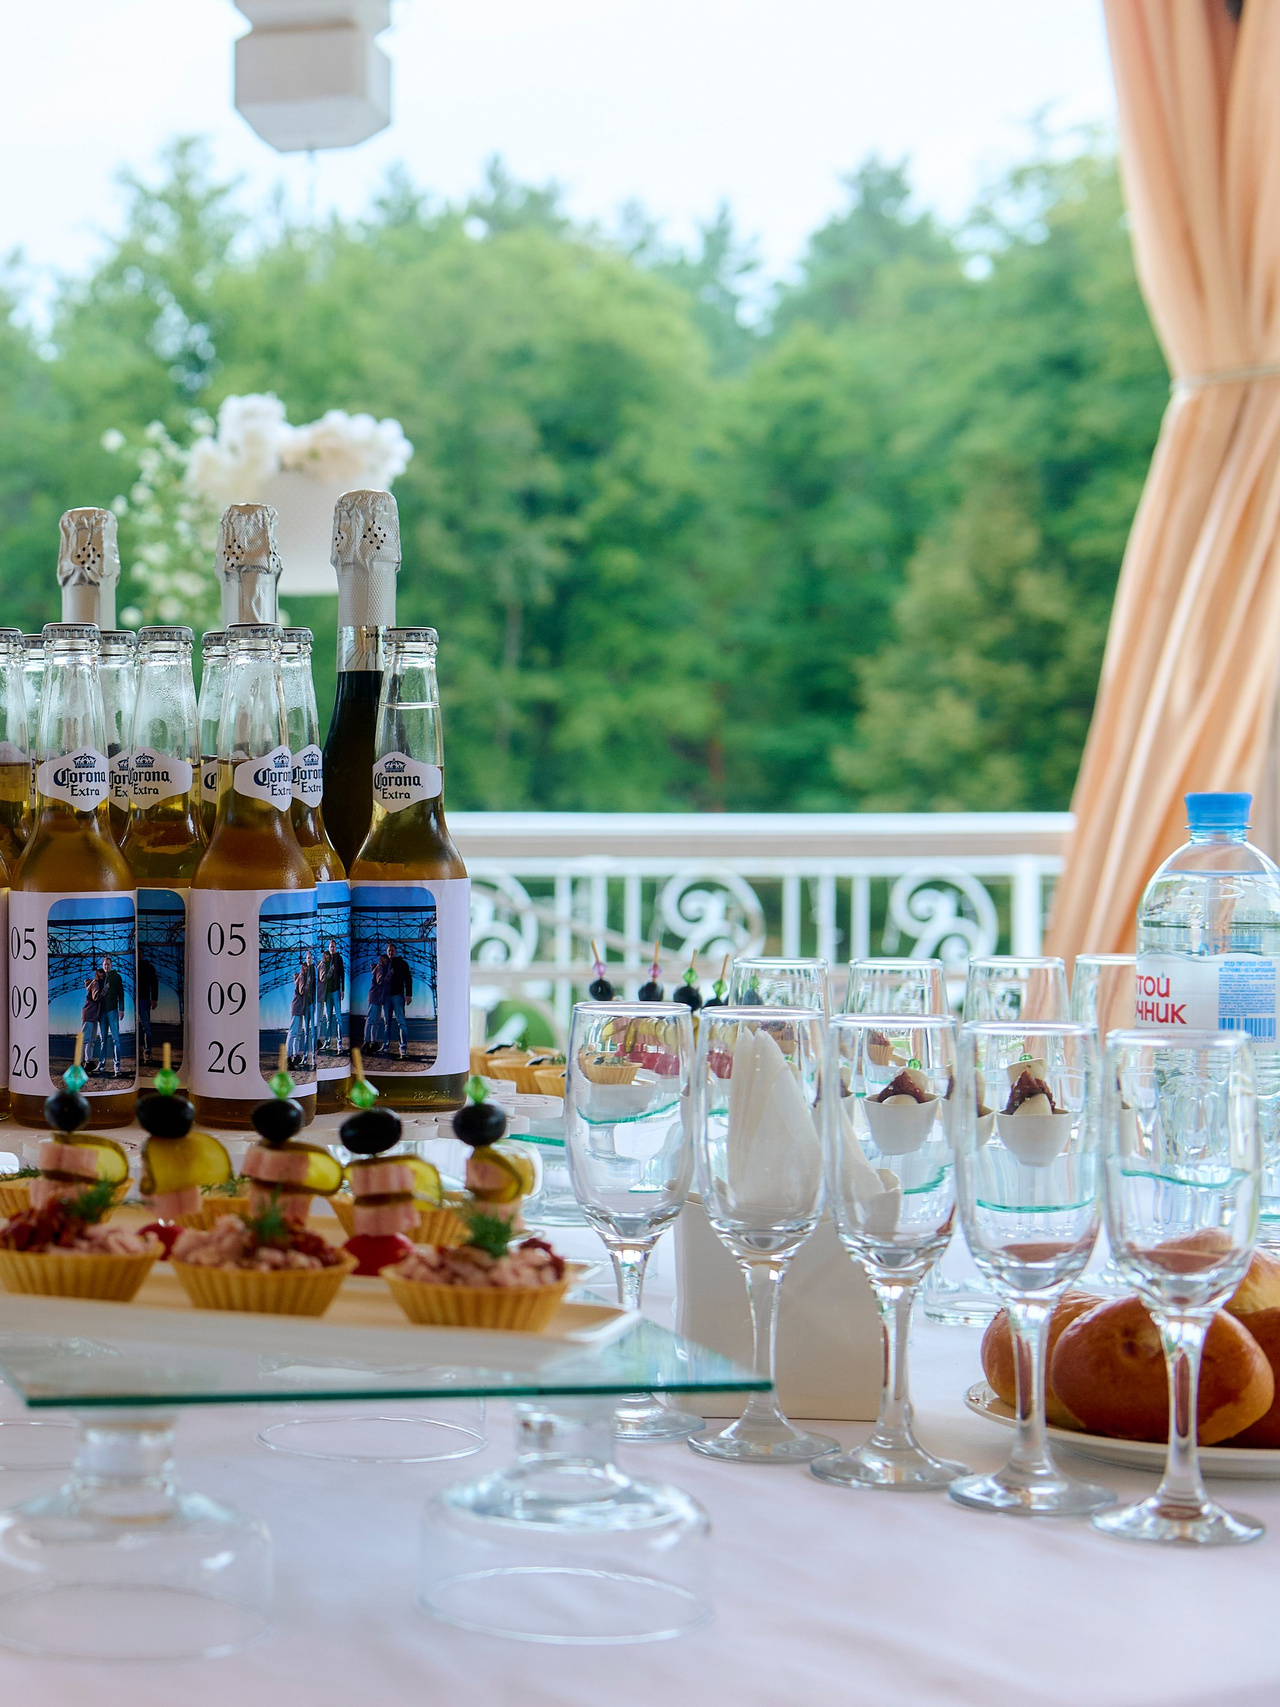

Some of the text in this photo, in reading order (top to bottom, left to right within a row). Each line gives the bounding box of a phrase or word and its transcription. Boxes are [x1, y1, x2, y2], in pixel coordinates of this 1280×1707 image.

[53, 767, 106, 788] Corona
[70, 785, 100, 796] Extra
[133, 783, 159, 795] Extra
[374, 772, 421, 791] Corona
[382, 788, 411, 799] Extra
[10, 926, 37, 961] 05
[207, 922, 247, 956] 05
[11, 985, 38, 1019] 09
[207, 981, 247, 1016] 09
[11, 1044, 39, 1079] 26
[207, 1041, 247, 1075] 26
